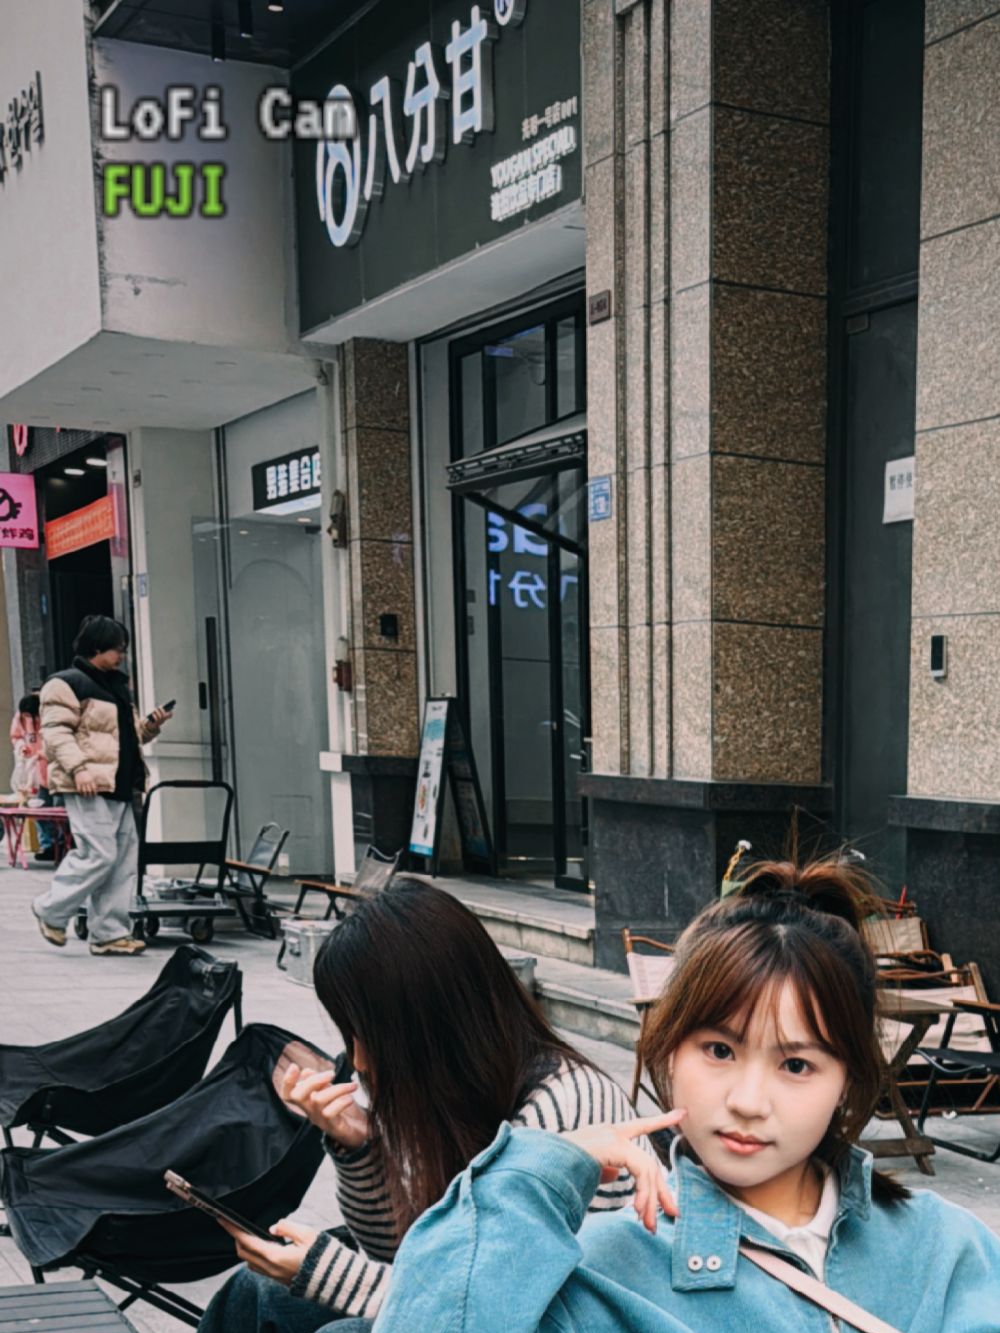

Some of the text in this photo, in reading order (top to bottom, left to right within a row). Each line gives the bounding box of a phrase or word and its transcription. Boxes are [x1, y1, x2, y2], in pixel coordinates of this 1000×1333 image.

[364, 5, 488, 201] 八分甘
[0, 527, 35, 540] 炸鸡
